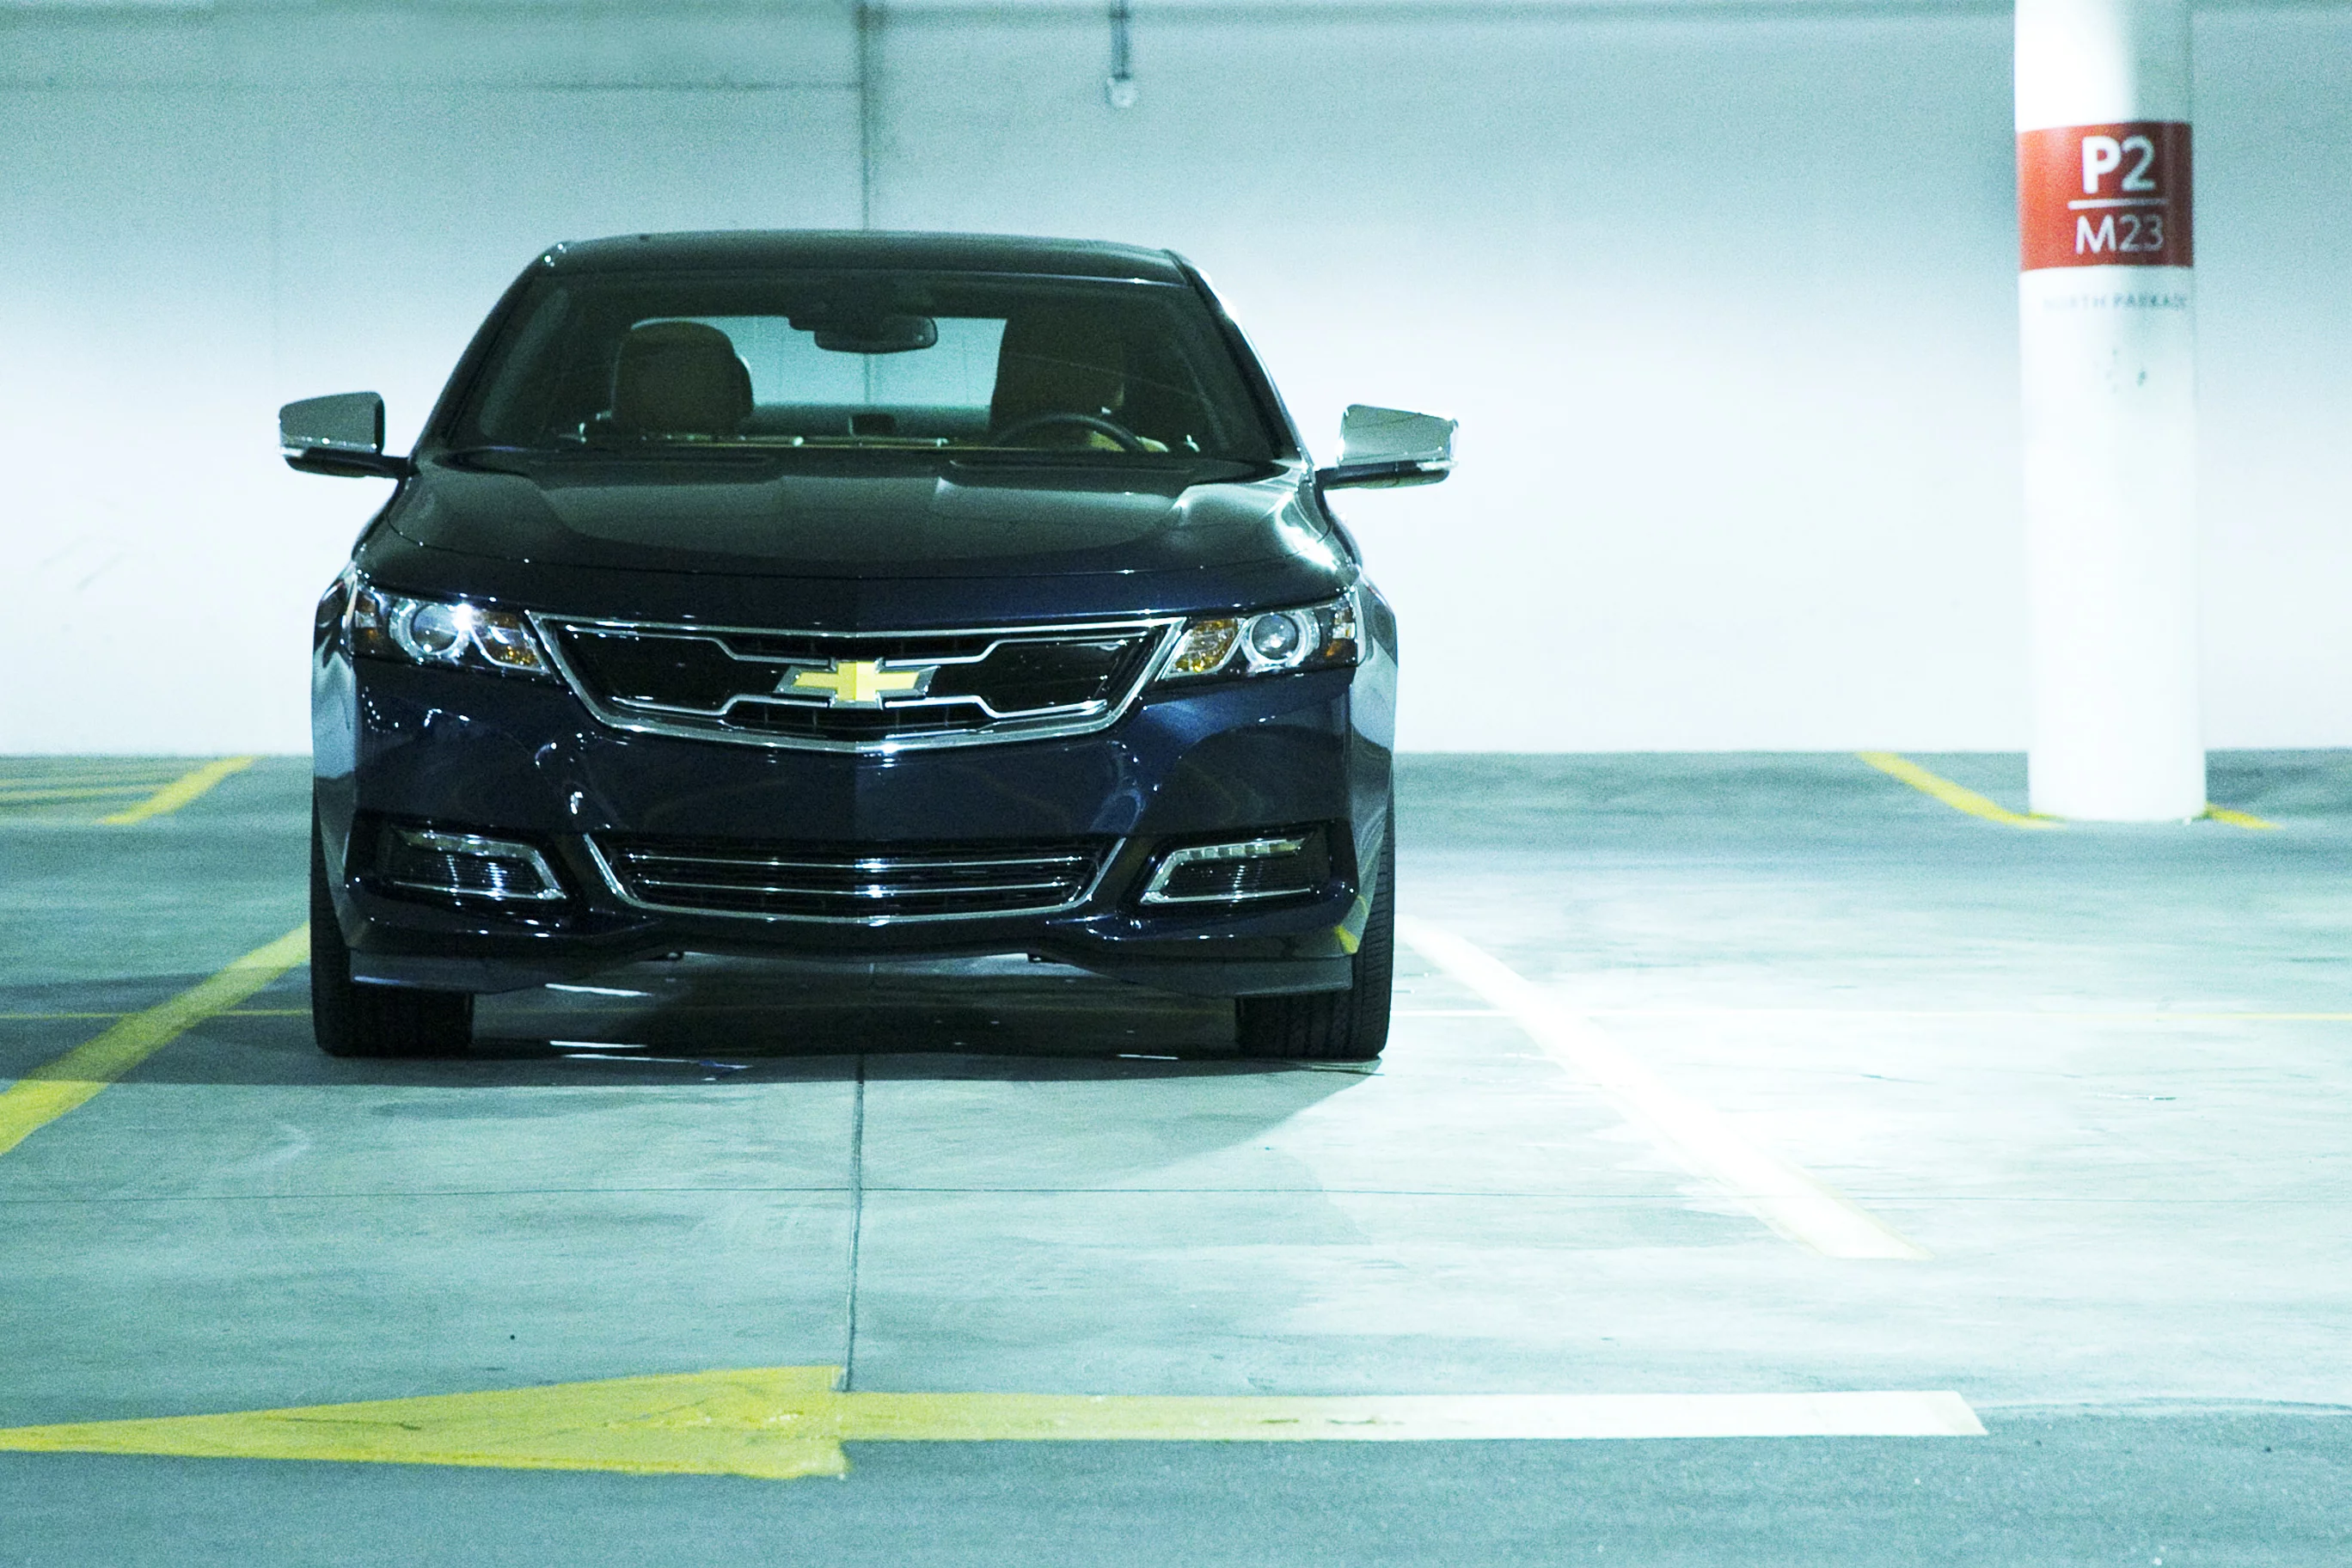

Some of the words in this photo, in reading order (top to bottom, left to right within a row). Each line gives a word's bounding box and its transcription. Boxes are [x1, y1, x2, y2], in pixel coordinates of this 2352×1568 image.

[2082, 135, 2156, 194] P2
[2075, 214, 2165, 254] M23
[2043, 292, 2106, 310] RTH
[2113, 291, 2188, 310] PARKAD
